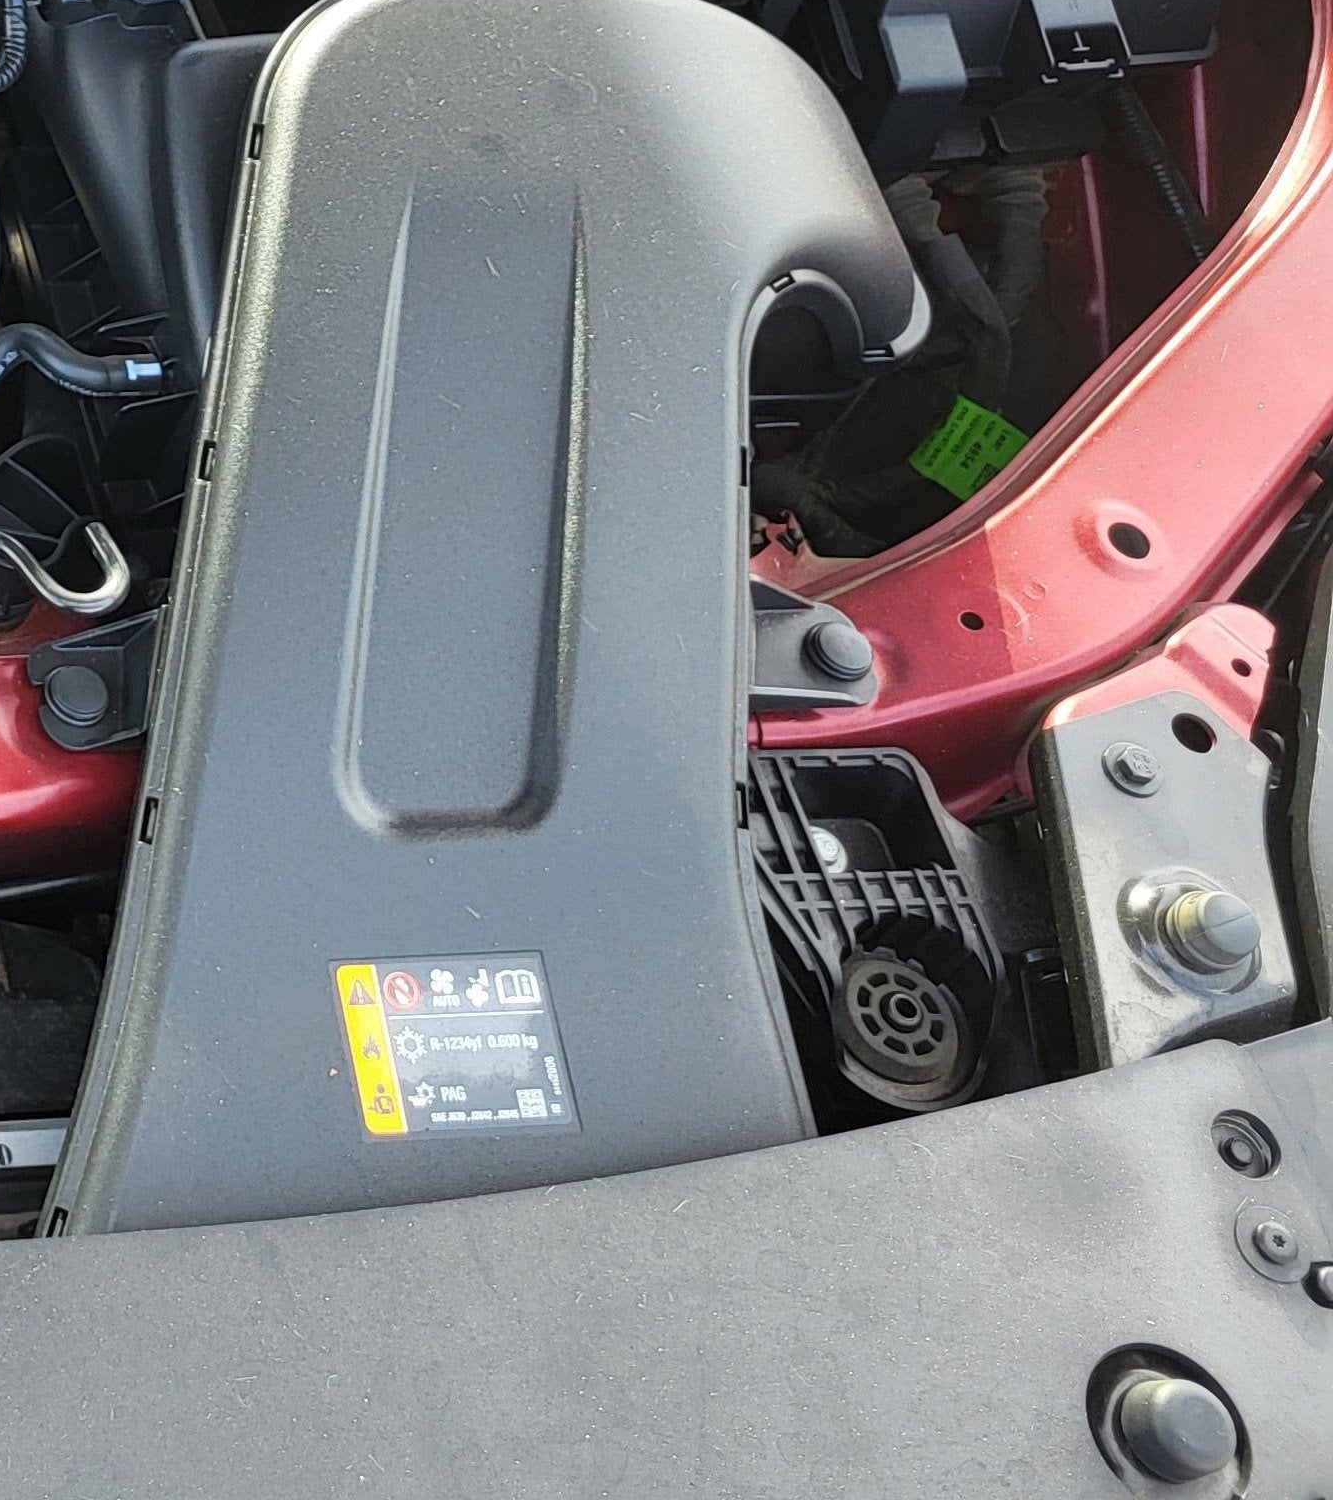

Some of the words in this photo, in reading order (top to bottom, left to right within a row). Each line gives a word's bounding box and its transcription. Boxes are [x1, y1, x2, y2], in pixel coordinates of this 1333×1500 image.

[432, 995, 460, 1008] AUTO
[430, 1035, 482, 1052] R-1234yf
[521, 1033, 538, 1050] kg
[440, 1086, 467, 1102] PAG
